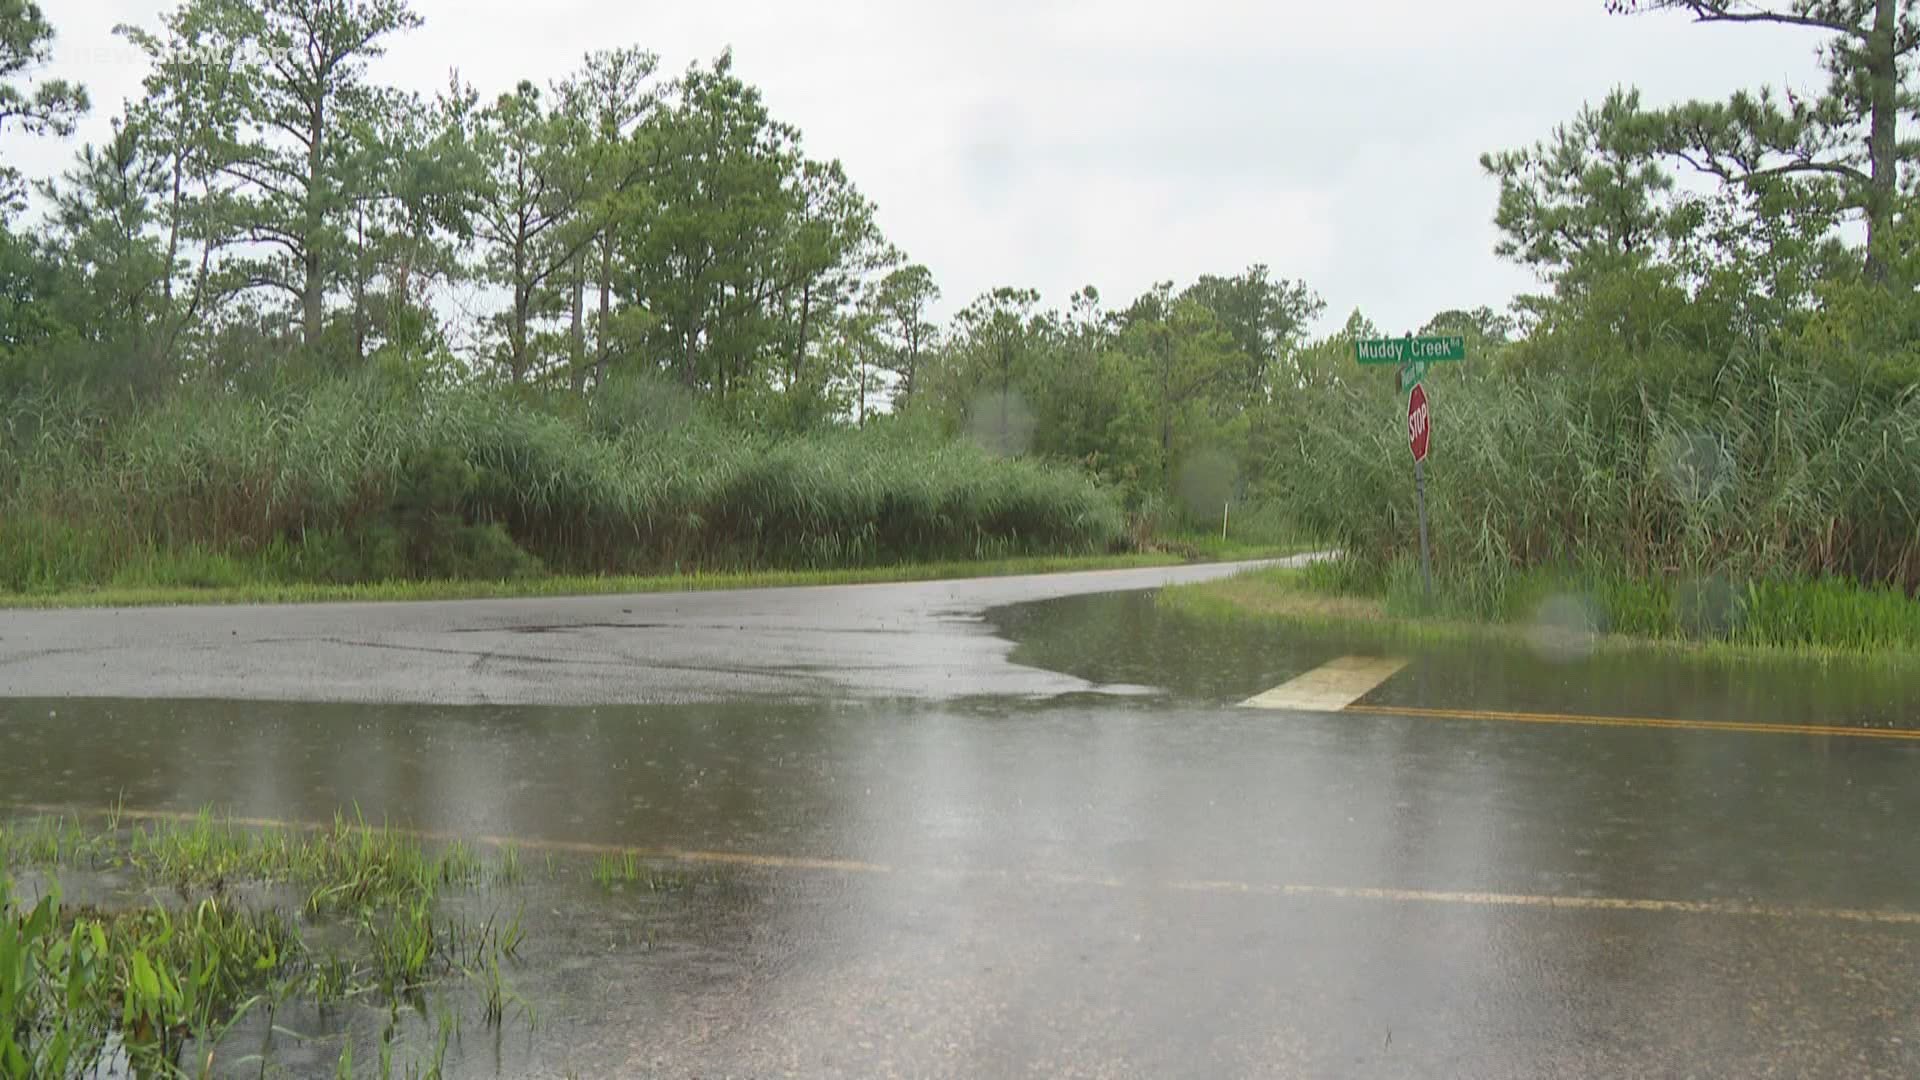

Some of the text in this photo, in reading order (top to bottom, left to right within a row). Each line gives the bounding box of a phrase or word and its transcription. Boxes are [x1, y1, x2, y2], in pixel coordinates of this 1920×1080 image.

[1359, 341, 1403, 360] Muddy
[1411, 338, 1451, 356] Creek
[1409, 402, 1427, 443] STOP
